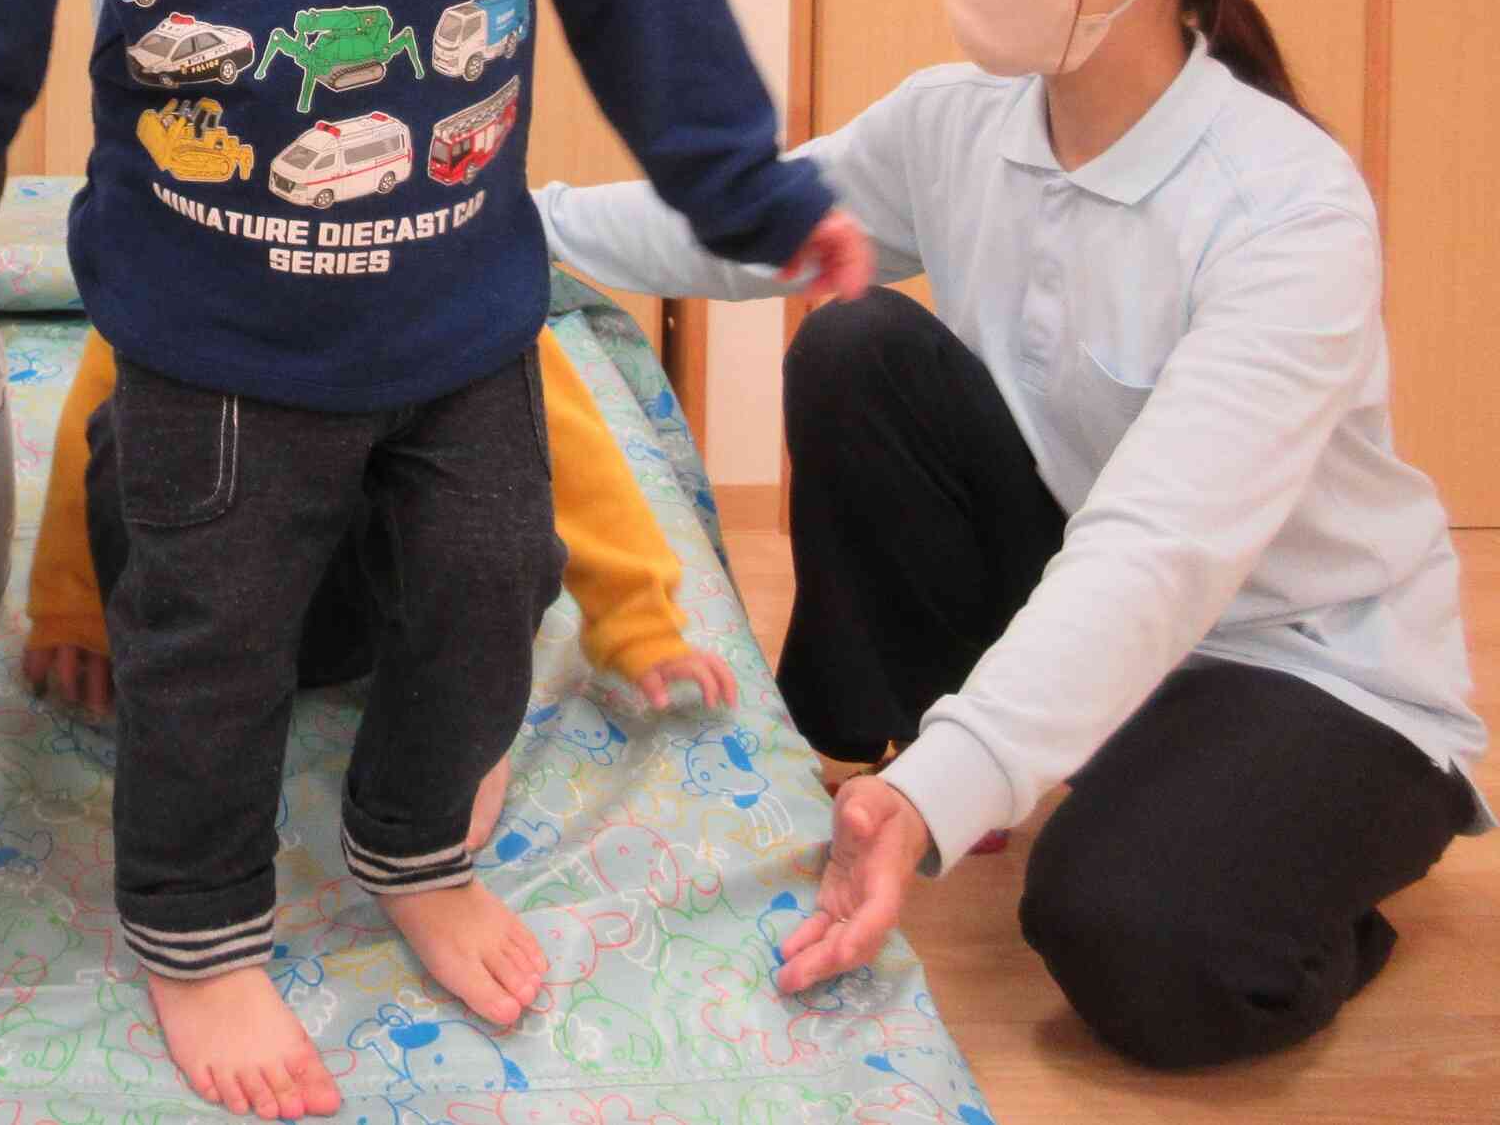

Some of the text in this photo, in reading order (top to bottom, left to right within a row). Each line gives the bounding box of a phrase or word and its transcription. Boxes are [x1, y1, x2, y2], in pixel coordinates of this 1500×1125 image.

[152, 181, 309, 246] MINIATURE
[318, 208, 450, 247] DIECAST
[268, 247, 392, 275] SERIES
